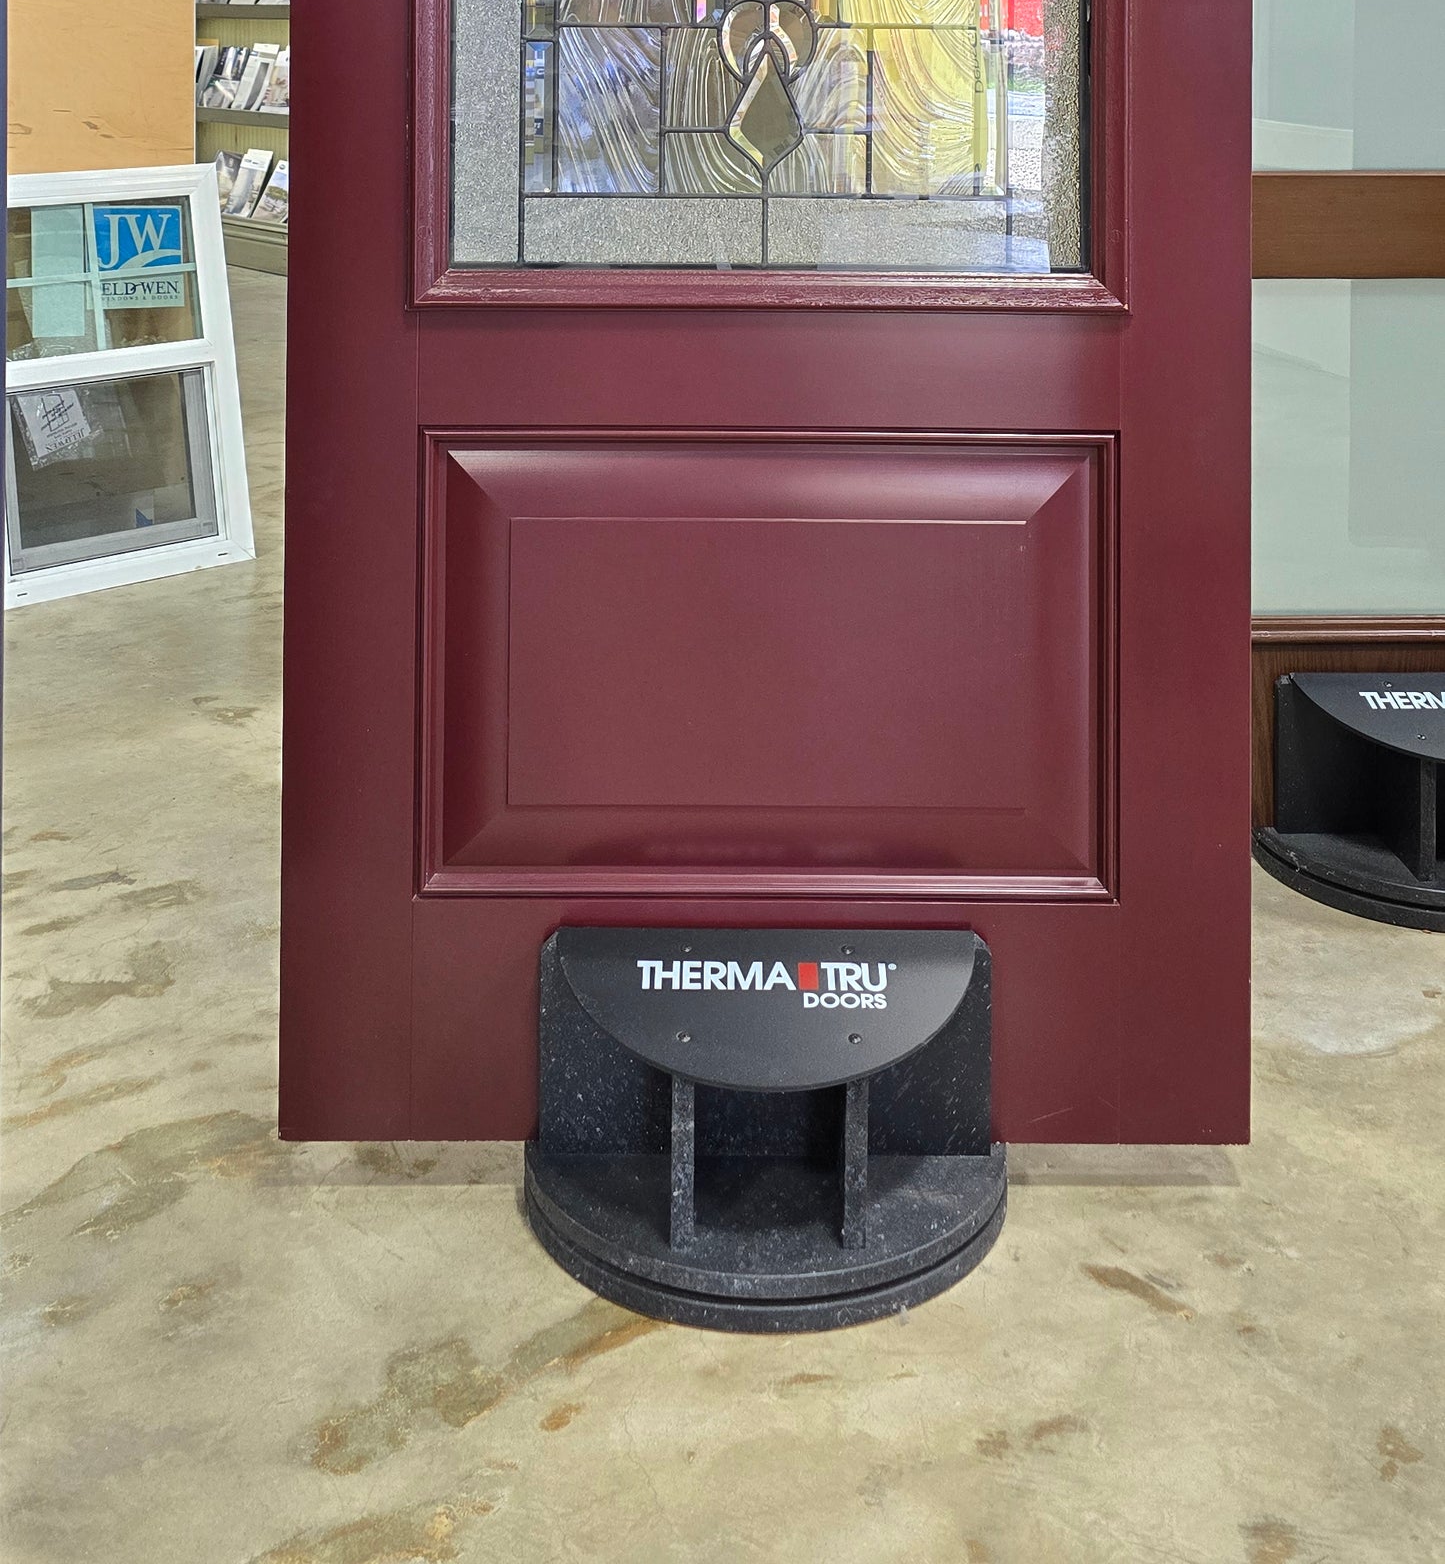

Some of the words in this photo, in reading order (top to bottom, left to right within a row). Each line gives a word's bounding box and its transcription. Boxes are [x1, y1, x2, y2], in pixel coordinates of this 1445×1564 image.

[98, 213, 172, 269] JW
[636, 959, 797, 991] THERMA
[803, 992, 888, 1009] DOORS
